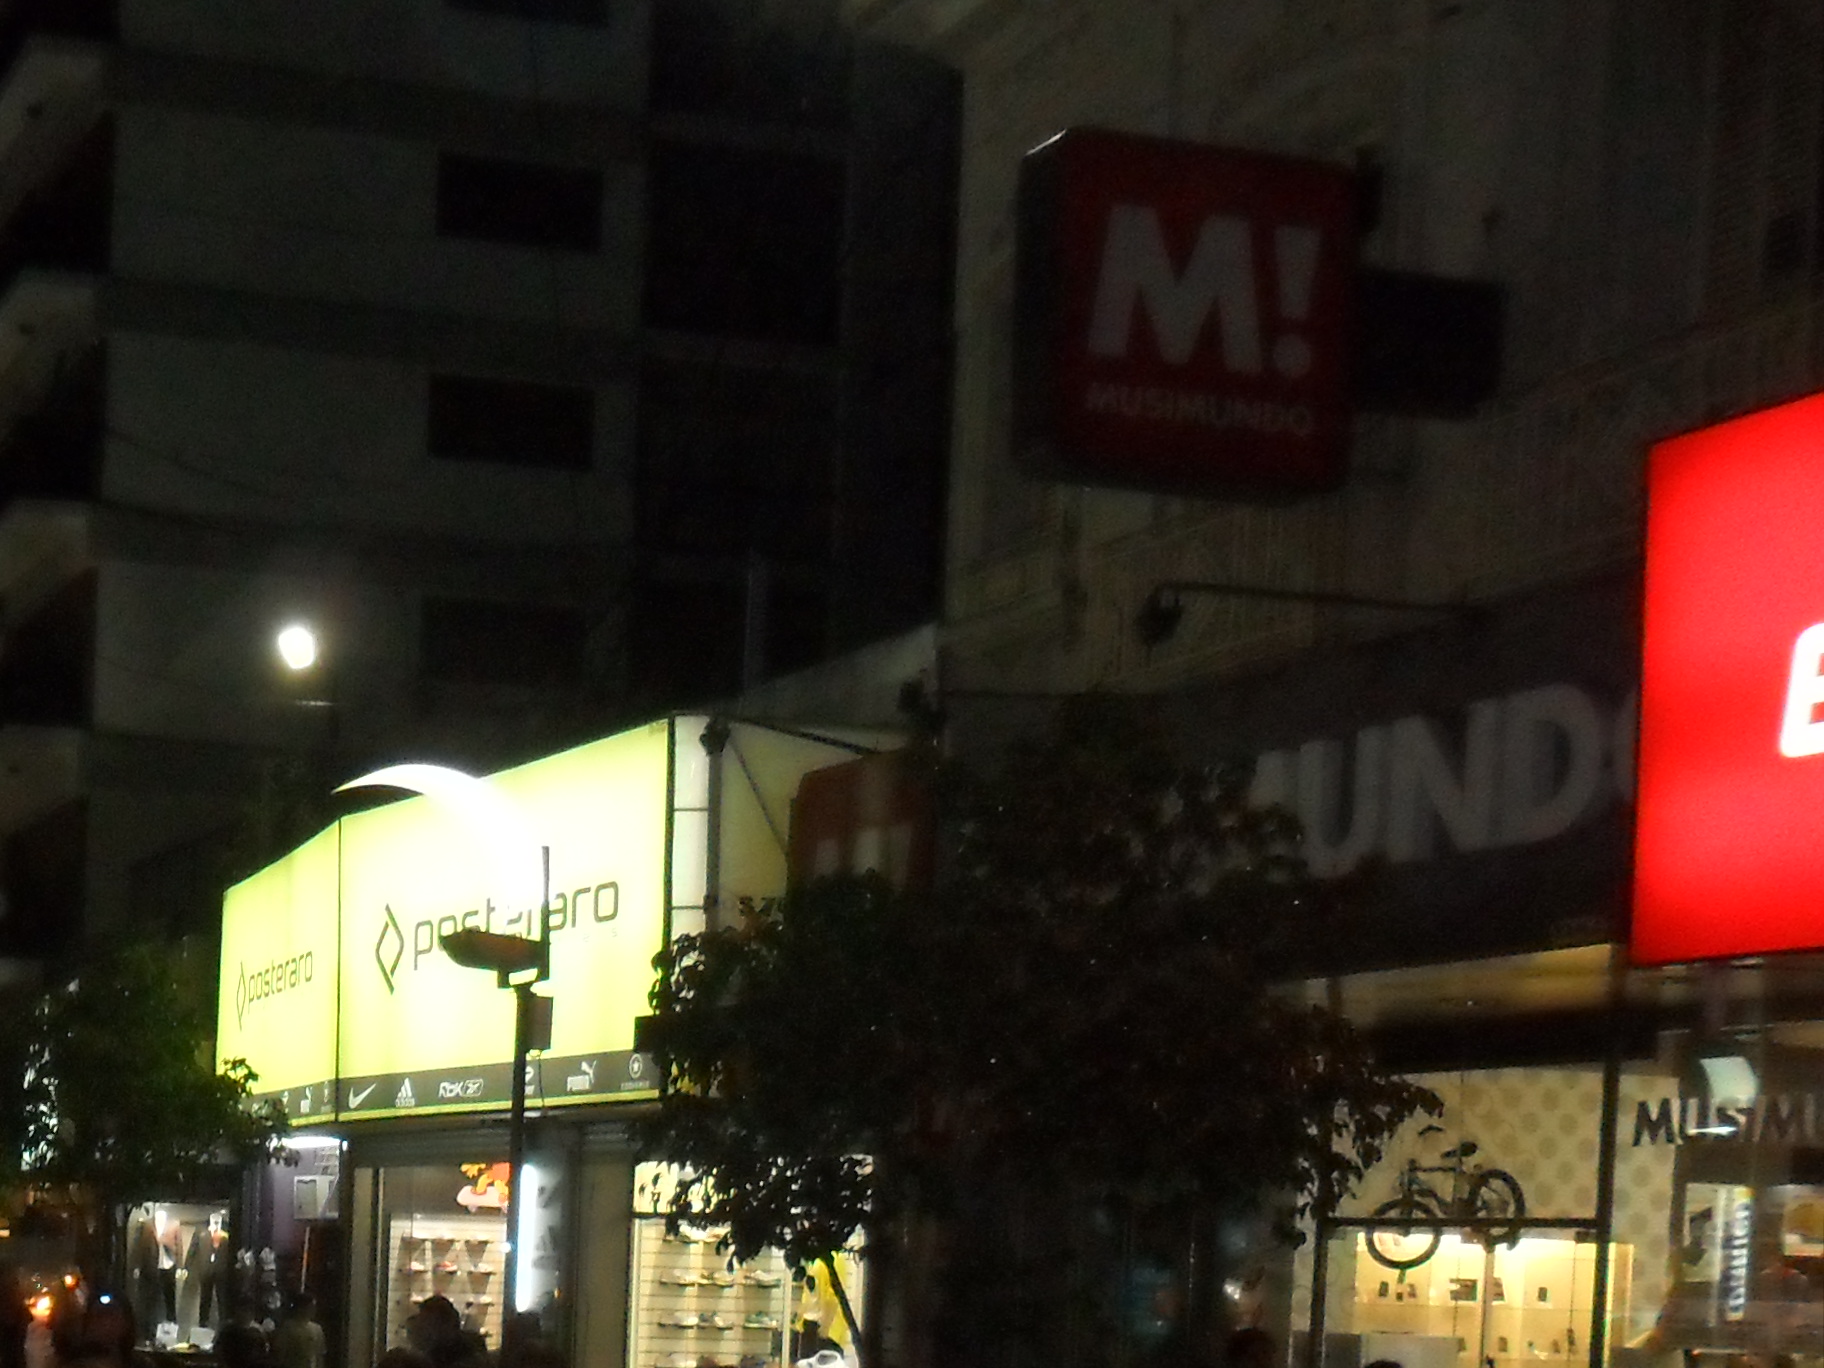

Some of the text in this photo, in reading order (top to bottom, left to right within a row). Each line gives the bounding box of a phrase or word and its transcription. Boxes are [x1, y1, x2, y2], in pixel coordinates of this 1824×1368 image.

[1087, 203, 1324, 381] M!
[1084, 381, 1314, 438] MUSIMUNDO
[1248, 684, 1638, 880] UND
[248, 950, 313, 1010] posteraro
